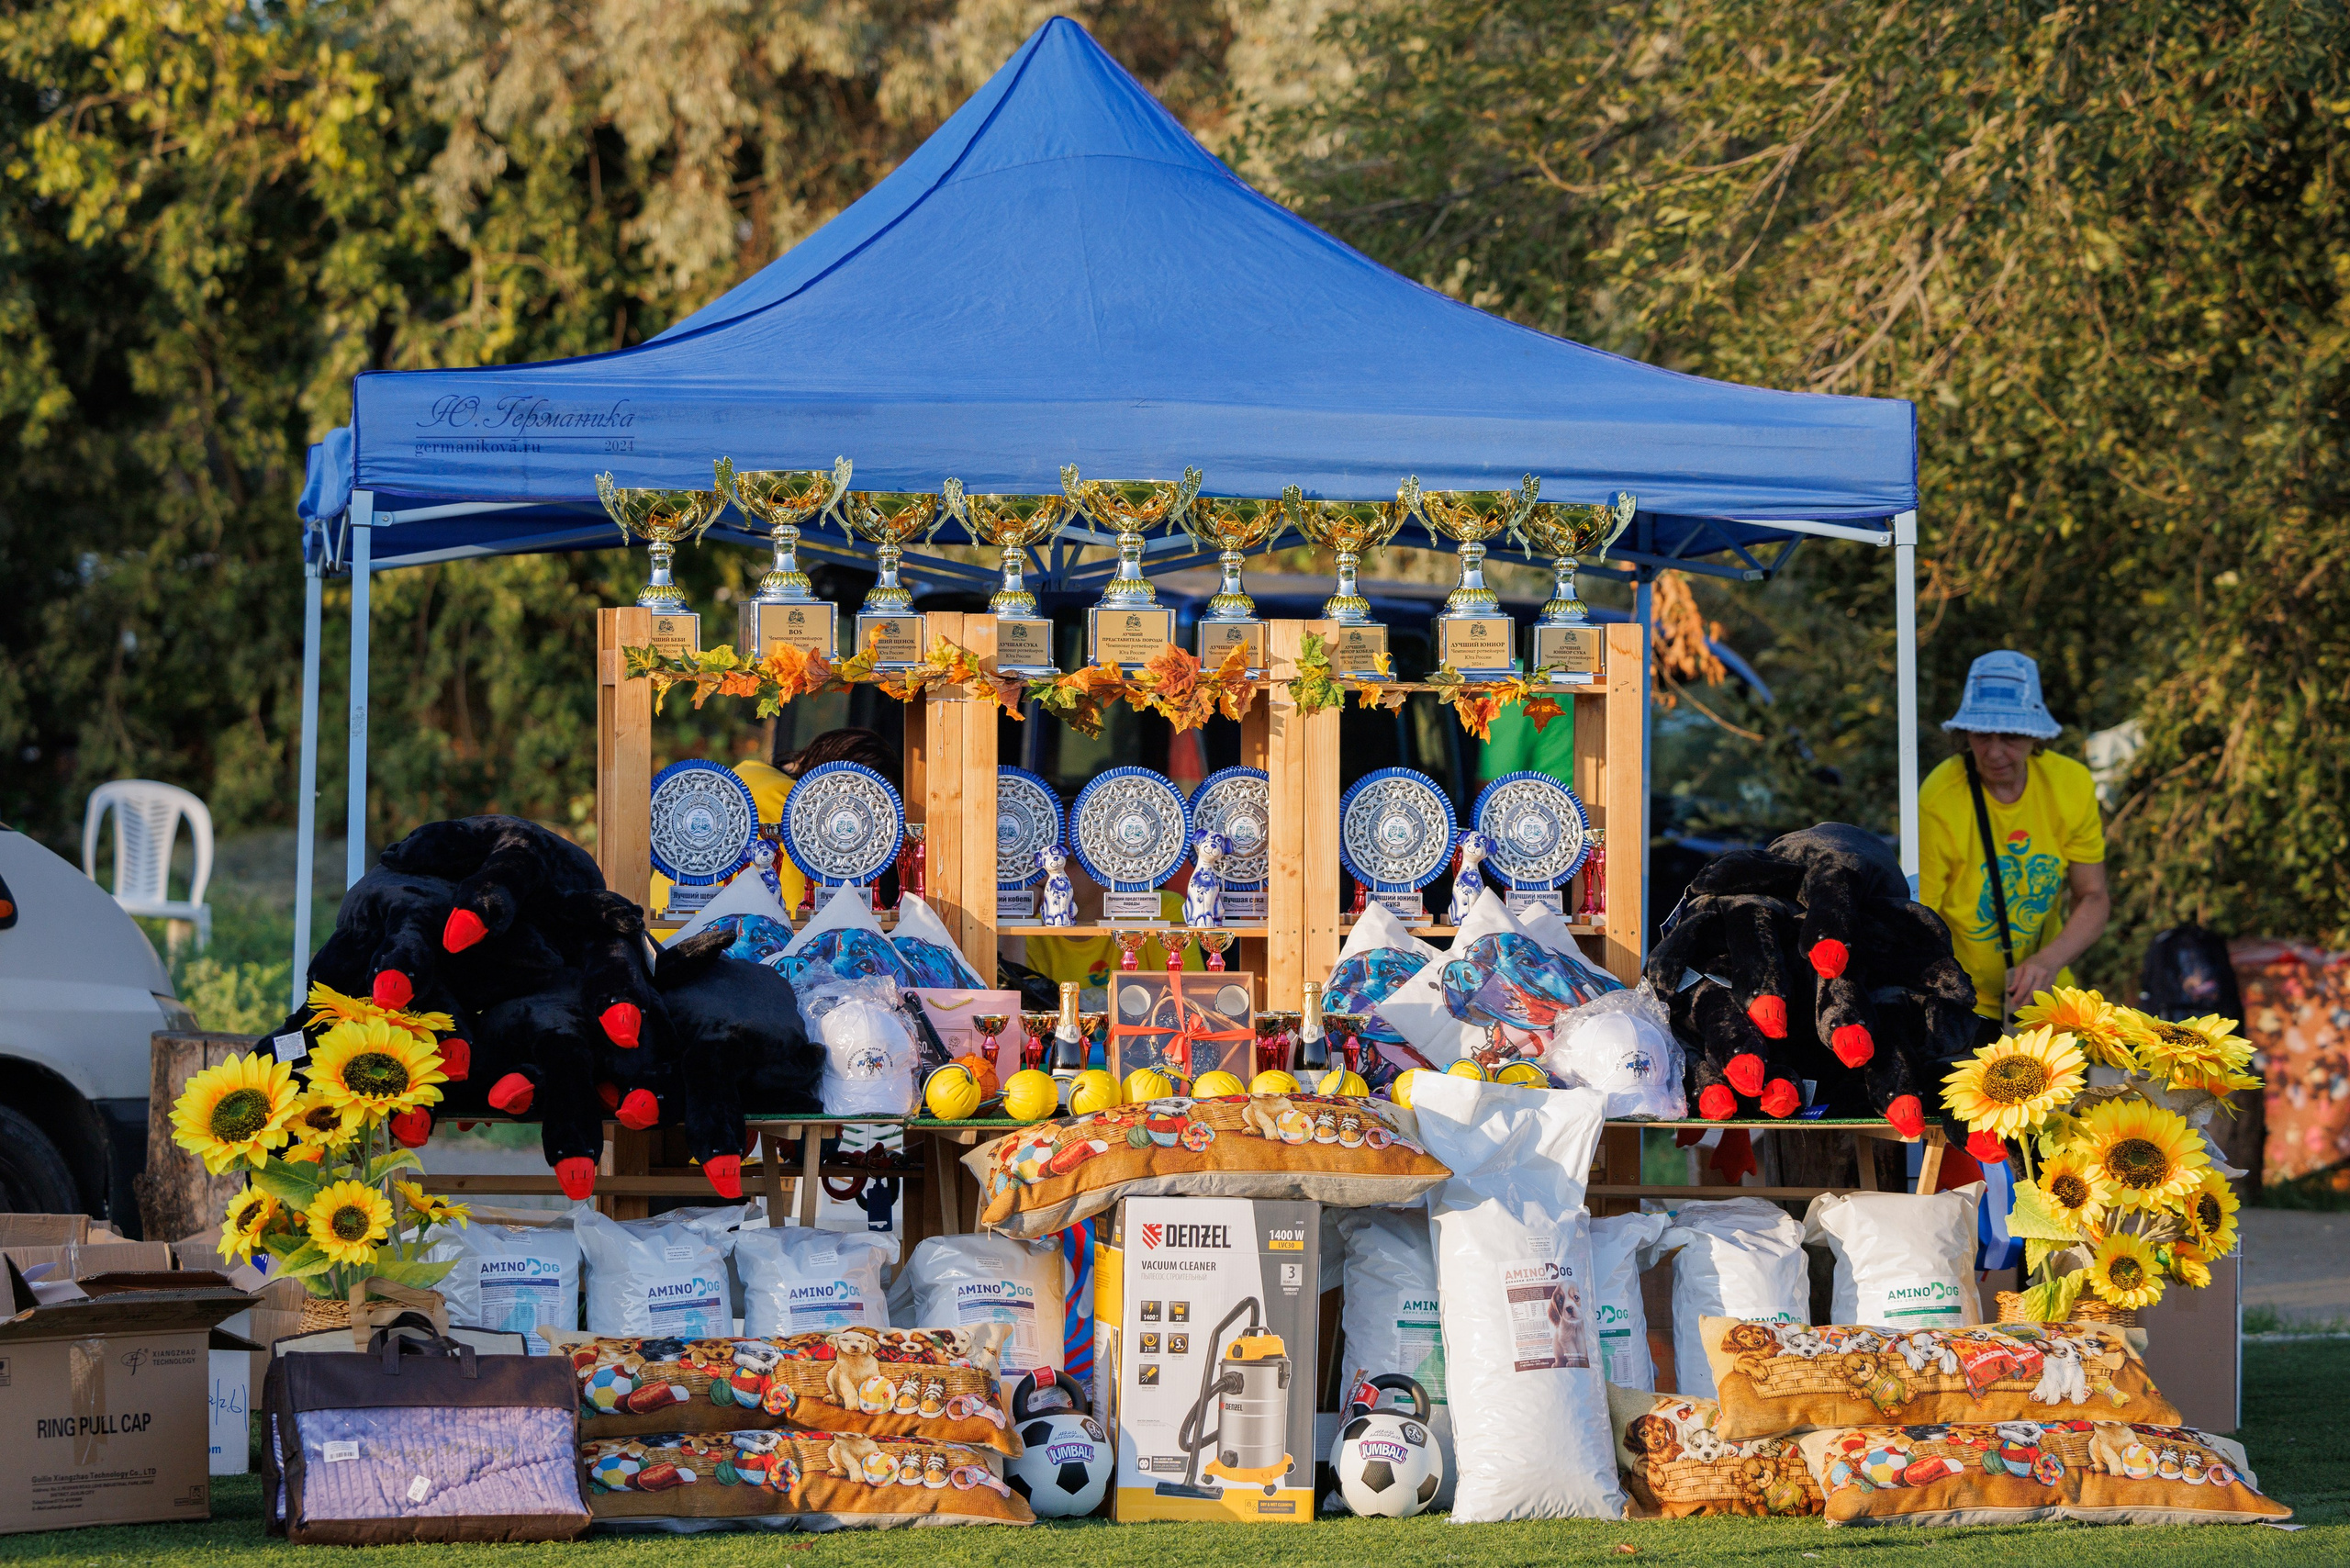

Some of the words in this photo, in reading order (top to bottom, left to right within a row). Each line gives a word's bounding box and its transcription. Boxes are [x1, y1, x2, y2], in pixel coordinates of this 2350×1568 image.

[1007, 894, 1032, 902] кобель
[1510, 892, 1536, 901] Лучший
[1165, 1224, 1232, 1249] DENZEL
[1269, 1229, 1292, 1240] 1400
[1294, 1229, 1304, 1240] W
[1141, 1260, 1178, 1271] VACUUM
[1179, 1261, 1217, 1271] CLEANER
[1166, 1272, 1208, 1282] СТРОИТЕЛЬНЫЙ
[1288, 1266, 1295, 1279] 3
[152, 1350, 196, 1358] XIANGZHAO
[152, 1357, 196, 1366] TECHNOLOGY
[1225, 1403, 1243, 1412] DENZEL
[38, 1417, 75, 1439] RING
[80, 1415, 118, 1436] PULL
[121, 1413, 151, 1433] CAP
[1048, 1444, 1093, 1464] JUMBALL
[1361, 1442, 1405, 1462] JUMBALL
[53, 1473, 94, 1483] Xiangzhao
[95, 1470, 129, 1480] Technology
